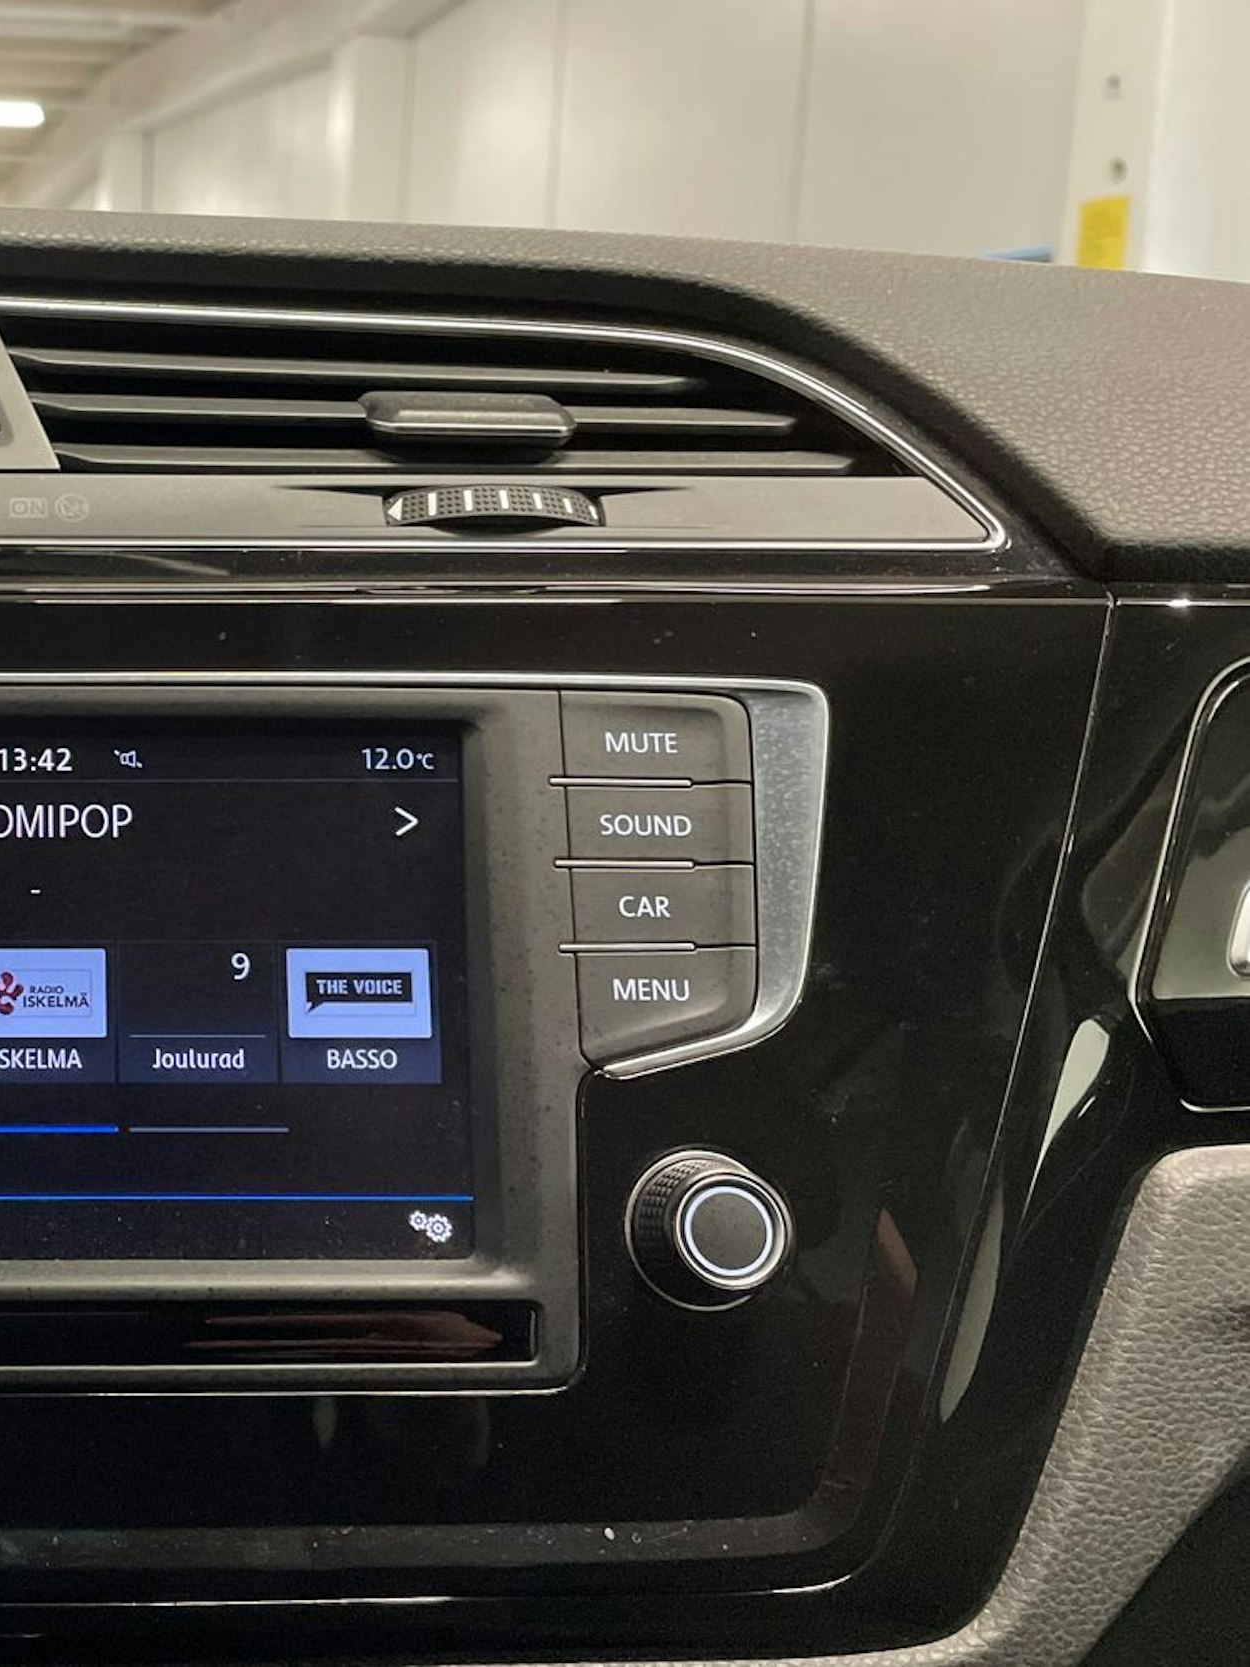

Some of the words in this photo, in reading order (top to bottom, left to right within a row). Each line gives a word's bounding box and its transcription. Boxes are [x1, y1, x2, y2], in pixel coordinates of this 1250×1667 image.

[12, 501, 48, 517] ON
[604, 731, 679, 755] MUTE
[599, 814, 693, 837] SOUND
[618, 895, 672, 919] CAR
[230, 953, 251, 981] 9
[29, 985, 65, 995] RADIO
[316, 979, 349, 995] THE
[353, 979, 403, 995] VOICE
[612, 978, 691, 1002] MENU
[22, 992, 90, 1009] ISKELMÄ
[152, 1047, 245, 1070] Joulurad
[326, 1049, 399, 1070] BASSO
